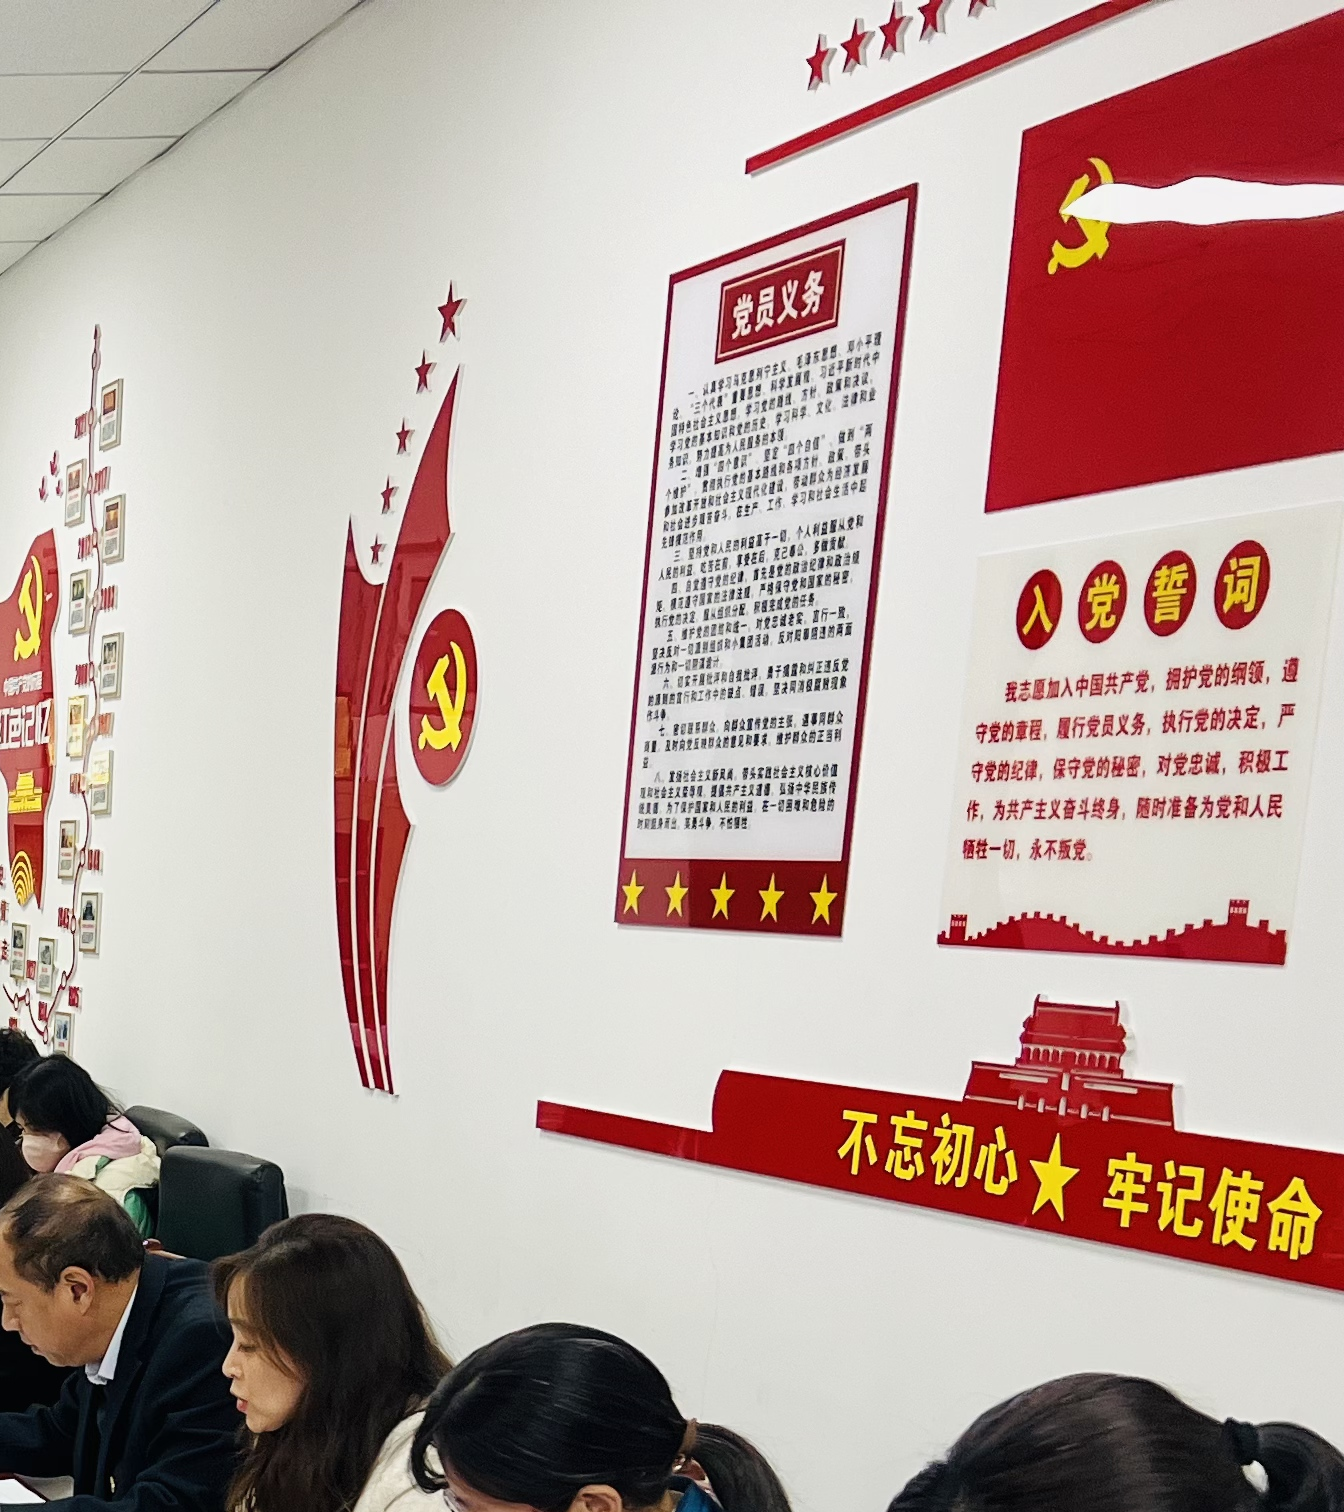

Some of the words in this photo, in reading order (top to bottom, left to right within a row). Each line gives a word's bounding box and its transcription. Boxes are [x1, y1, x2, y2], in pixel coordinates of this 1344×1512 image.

[732, 270, 825, 340] 党员义务
[1022, 556, 1262, 635] 入党誓词
[1006, 657, 1299, 702] 我志愿加入中国共产党，拥护党的纲领，遵
[976, 704, 1294, 743] 守党的章程，履行党员义务，执行党的决定，严
[972, 750, 1288, 782] 守党的纪律，保守党的秘密，对党忠诚，积极工
[968, 794, 1282, 820] 作，为共产主义奋斗终身，随时准备为党和人民
[963, 839, 1093, 860] 牺牲一切，永不叛党。
[838, 1109, 1018, 1196] 不忘初心
[1102, 1152, 1323, 1260] 牢记使命
